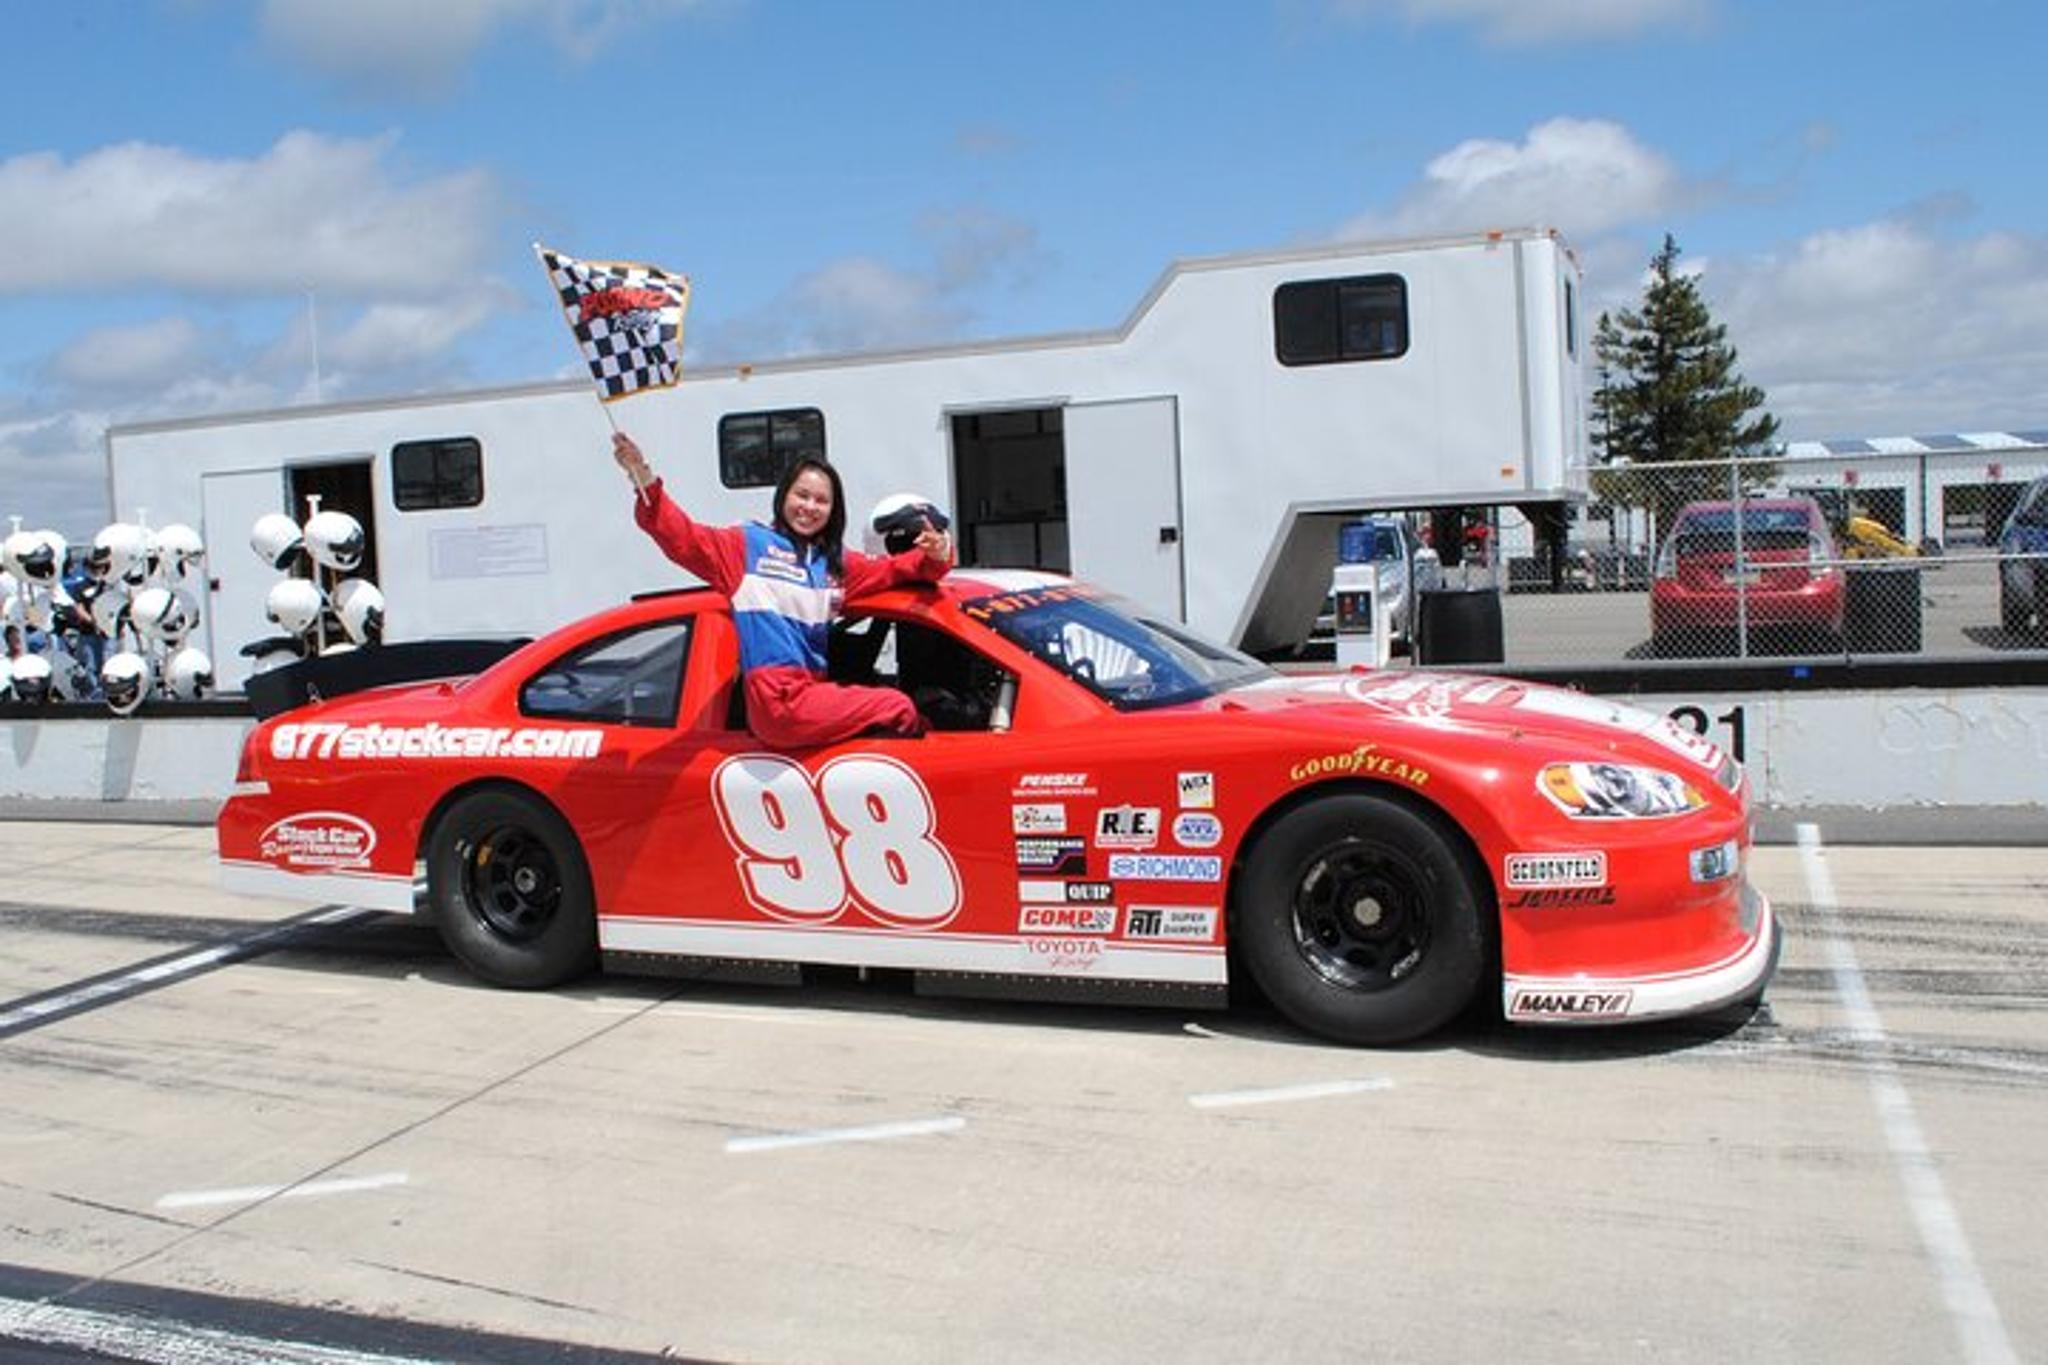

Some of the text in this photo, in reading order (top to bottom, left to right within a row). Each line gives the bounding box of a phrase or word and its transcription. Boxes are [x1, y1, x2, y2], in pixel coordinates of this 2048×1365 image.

[1290, 752, 1429, 785] GOODYEAR
[711, 754, 963, 929] 98
[1137, 857, 1218, 879] RICHMOND
[1024, 910, 1094, 925] COMP
[1026, 940, 1101, 954] TOYOTA
[1519, 995, 1612, 1013] MANLEY
